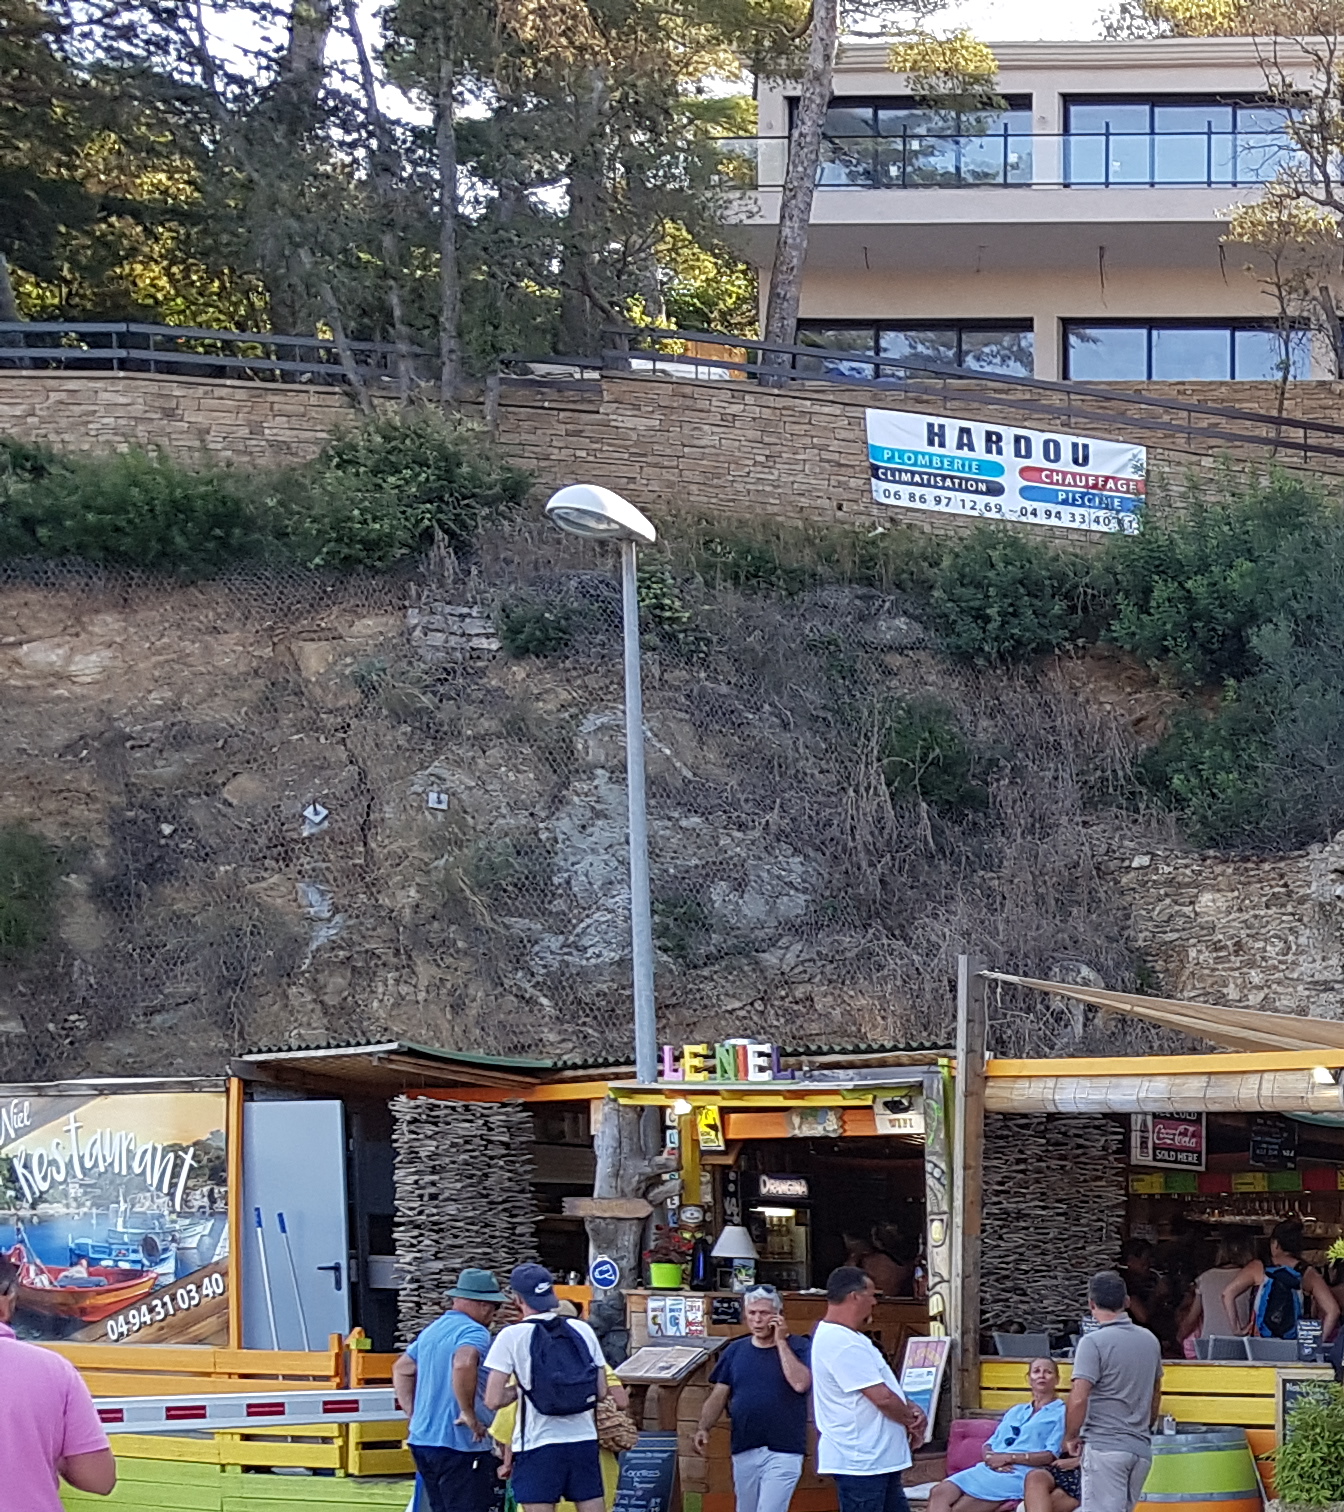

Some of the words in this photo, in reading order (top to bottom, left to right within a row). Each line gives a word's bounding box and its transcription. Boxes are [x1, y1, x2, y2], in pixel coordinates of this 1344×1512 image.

[926, 422, 1090, 468] HARDOU
[883, 450, 980, 474] PLOMBERIE
[878, 468, 987, 493] CLIMATISATION
[1041, 470, 1137, 494] CHAUFFAGE
[883, 488, 901, 501] 06
[908, 491, 927, 504] 86
[934, 495, 952, 508] 97
[961, 498, 977, 511] 12
[984, 502, 1003, 515] 69
[1020, 506, 1037, 519] 04
[1044, 509, 1062, 522] 94
[1068, 512, 1086, 525] 33
[1093, 514, 1110, 528] 40
[1058, 491, 1122, 511] PISCINE
[663, 1044, 709, 1081] LE
[714, 1043, 796, 1082] NIEL
[13, 1112, 198, 1212] Restaurant
[1155, 1150, 1176, 1161] SOLD
[1177, 1151, 1199, 1163] HERE
[107, 1314, 128, 1341] 04
[128, 1306, 151, 1334] 94
[148, 1296, 175, 1321] 31
[176, 1283, 201, 1311] 03
[202, 1272, 225, 1297] 40
